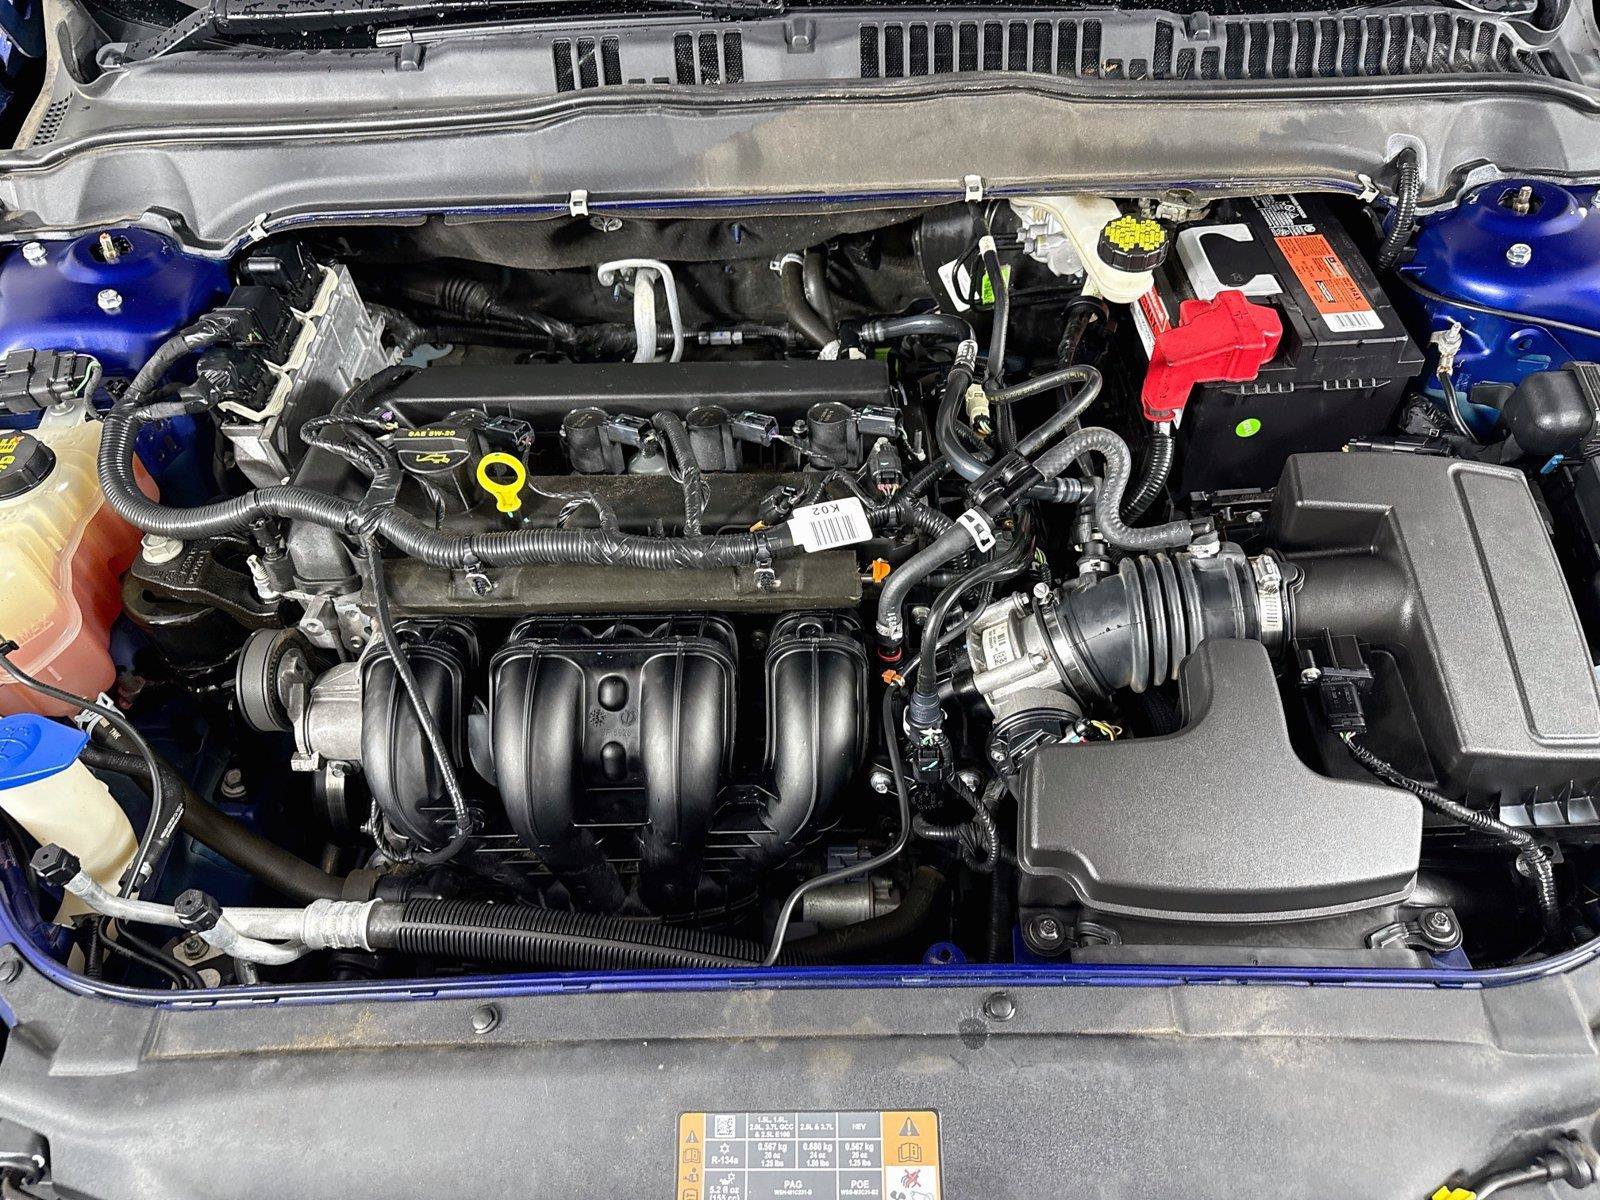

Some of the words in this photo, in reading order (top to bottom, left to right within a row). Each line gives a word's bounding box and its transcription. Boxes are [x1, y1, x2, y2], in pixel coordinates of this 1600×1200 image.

[812, 503, 840, 516] K02
[757, 1142, 777, 1151] 0.567
[778, 1142, 788, 1153] kg
[802, 1142, 822, 1151] 0.680
[823, 1142, 833, 1153] kg
[844, 1142, 864, 1151] 0.567
[864, 1142, 875, 1153] kg
[711, 1156, 739, 1165] R-134a
[774, 1159, 784, 1167] lbs
[819, 1159, 830, 1167] lbs
[861, 1159, 872, 1167] lbs
[784, 1180, 803, 1189] PAG
[851, 1180, 870, 1189] POE
[709, 1186, 722, 1194] 5.2
